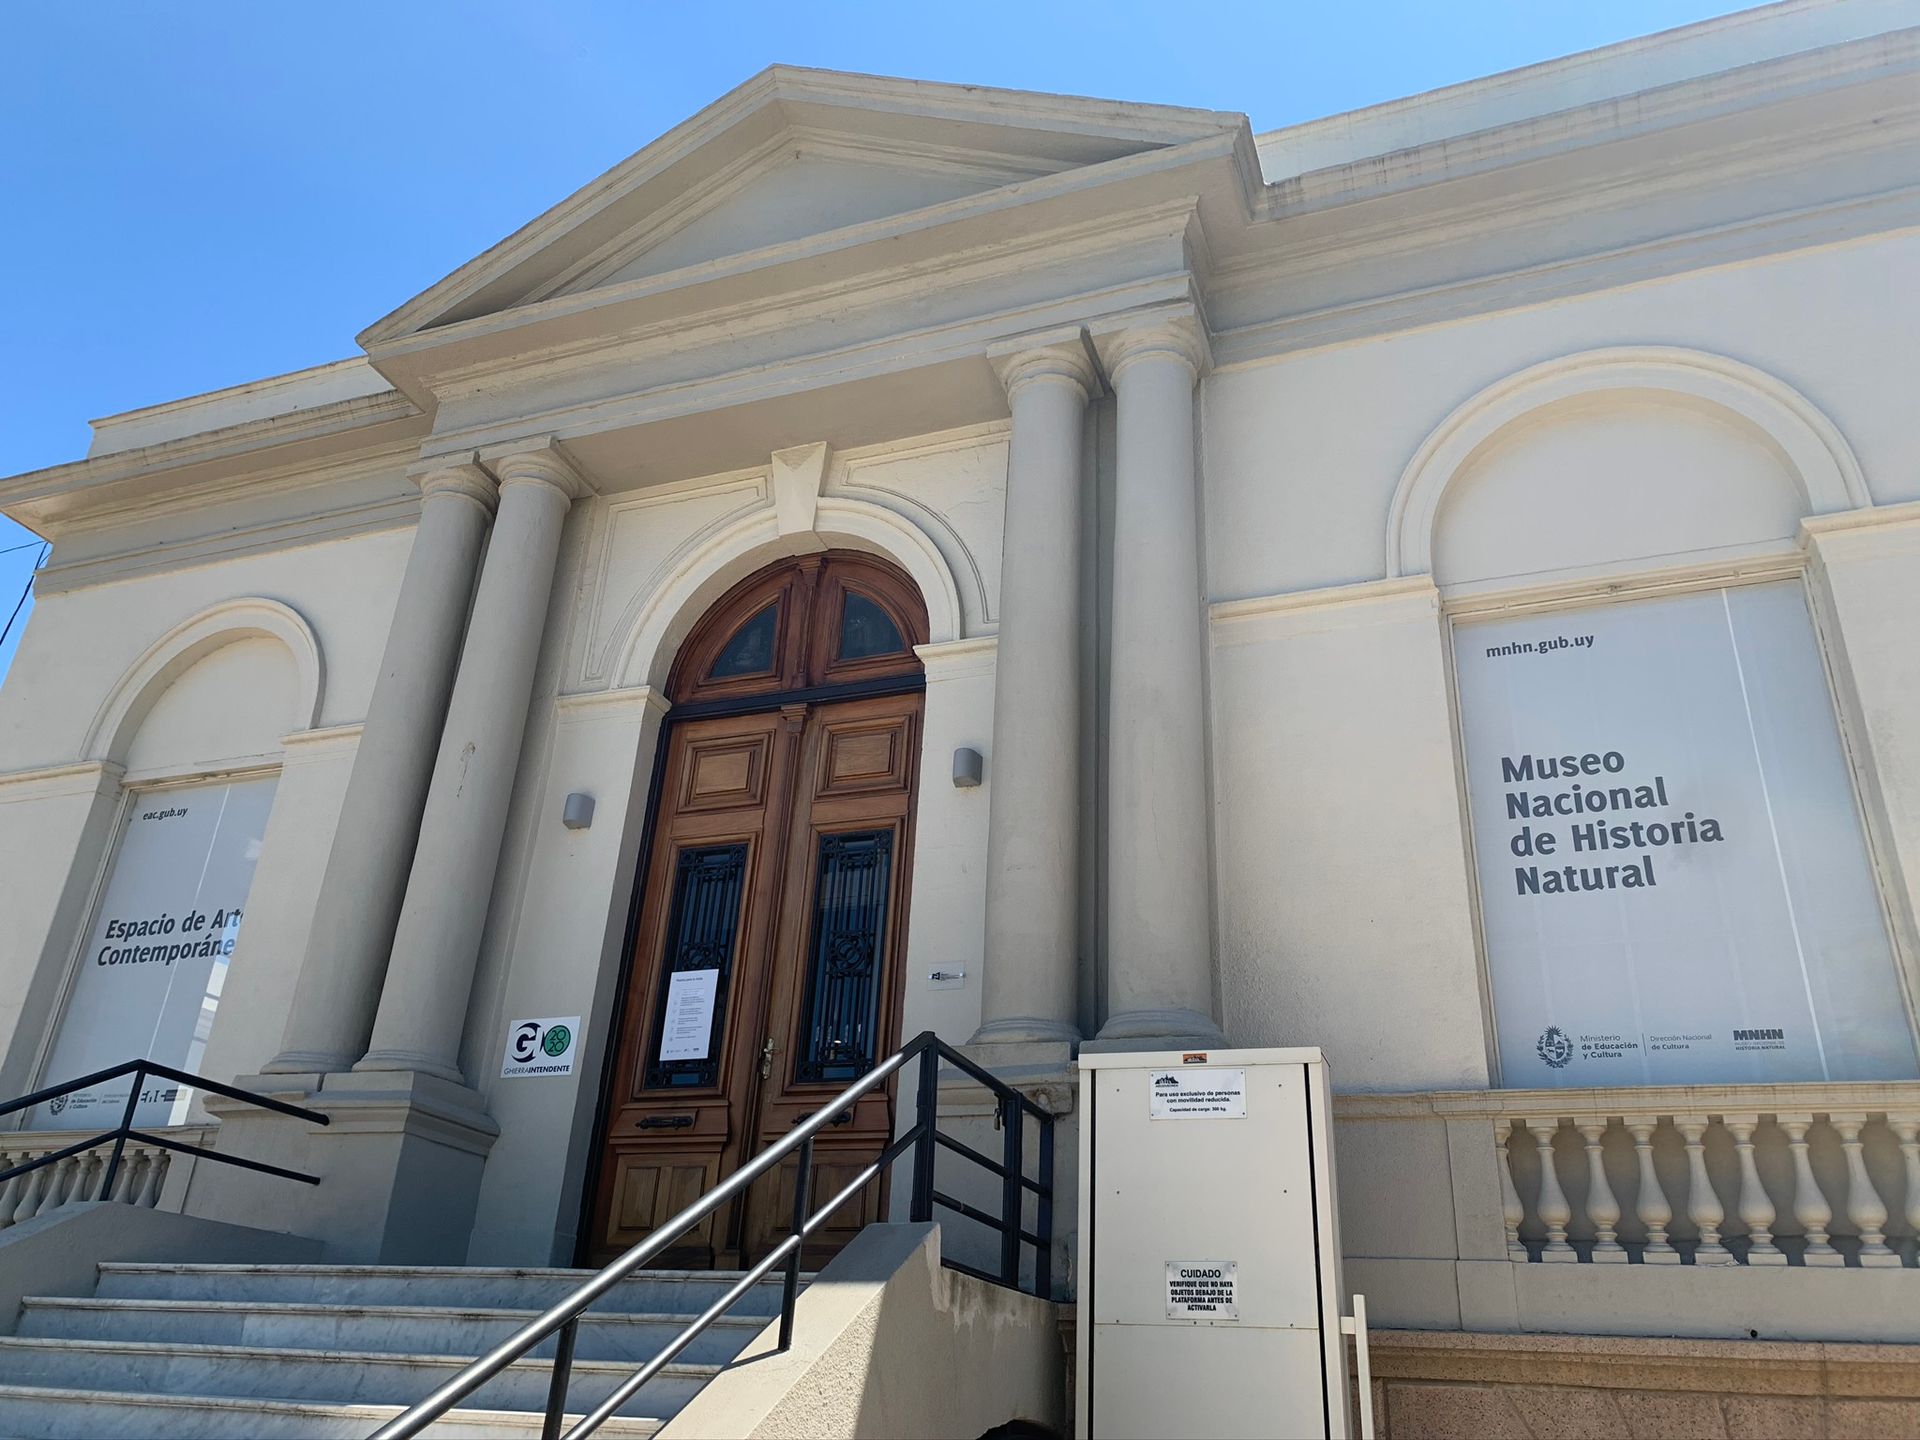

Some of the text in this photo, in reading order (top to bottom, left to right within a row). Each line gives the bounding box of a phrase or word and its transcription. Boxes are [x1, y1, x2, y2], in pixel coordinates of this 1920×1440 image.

[1486, 635, 1594, 657] mnhn.gub.uy
[1501, 751, 1625, 783] Museo
[1505, 776, 1669, 819] Nacional
[143, 808, 188, 820] eac.gub.uy
[1510, 812, 1724, 857] de Historia
[1515, 855, 1656, 895] Natural
[105, 909, 243, 942] Espacio de Art
[98, 933, 235, 966] Contemporáne
[1595, 1042, 1638, 1050] Educación
[1683, 1033, 1712, 1041] Nacional
[1733, 1029, 1784, 1041] MNHN
[1180, 1269, 1221, 1278] CUIDADO
